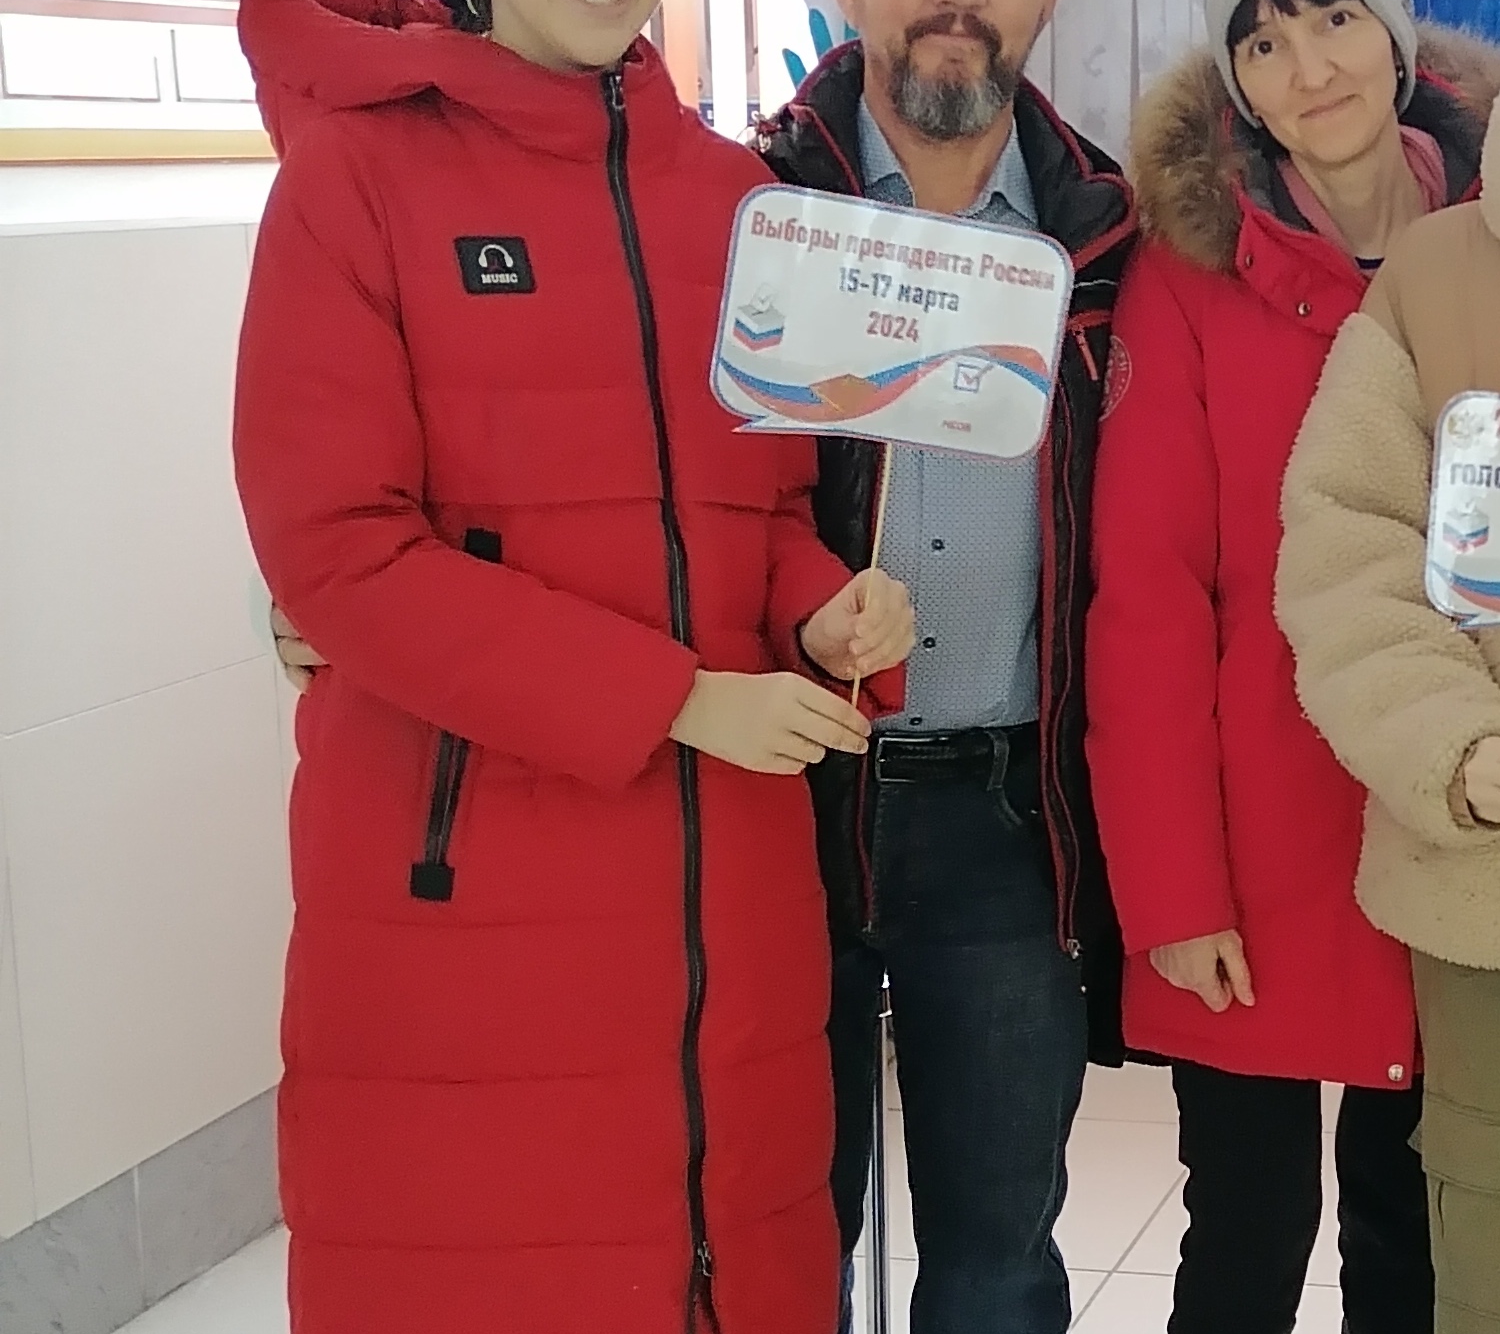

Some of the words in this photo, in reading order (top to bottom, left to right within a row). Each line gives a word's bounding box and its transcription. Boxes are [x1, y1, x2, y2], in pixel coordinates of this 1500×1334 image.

[751, 211, 839, 252] Выборы
[845, 233, 973, 276] президента
[979, 253, 1055, 292] России
[481, 273, 518, 284] MUSIC
[838, 267, 891, 300] 15-17
[898, 282, 960, 313] марта
[866, 311, 920, 343] 2024
